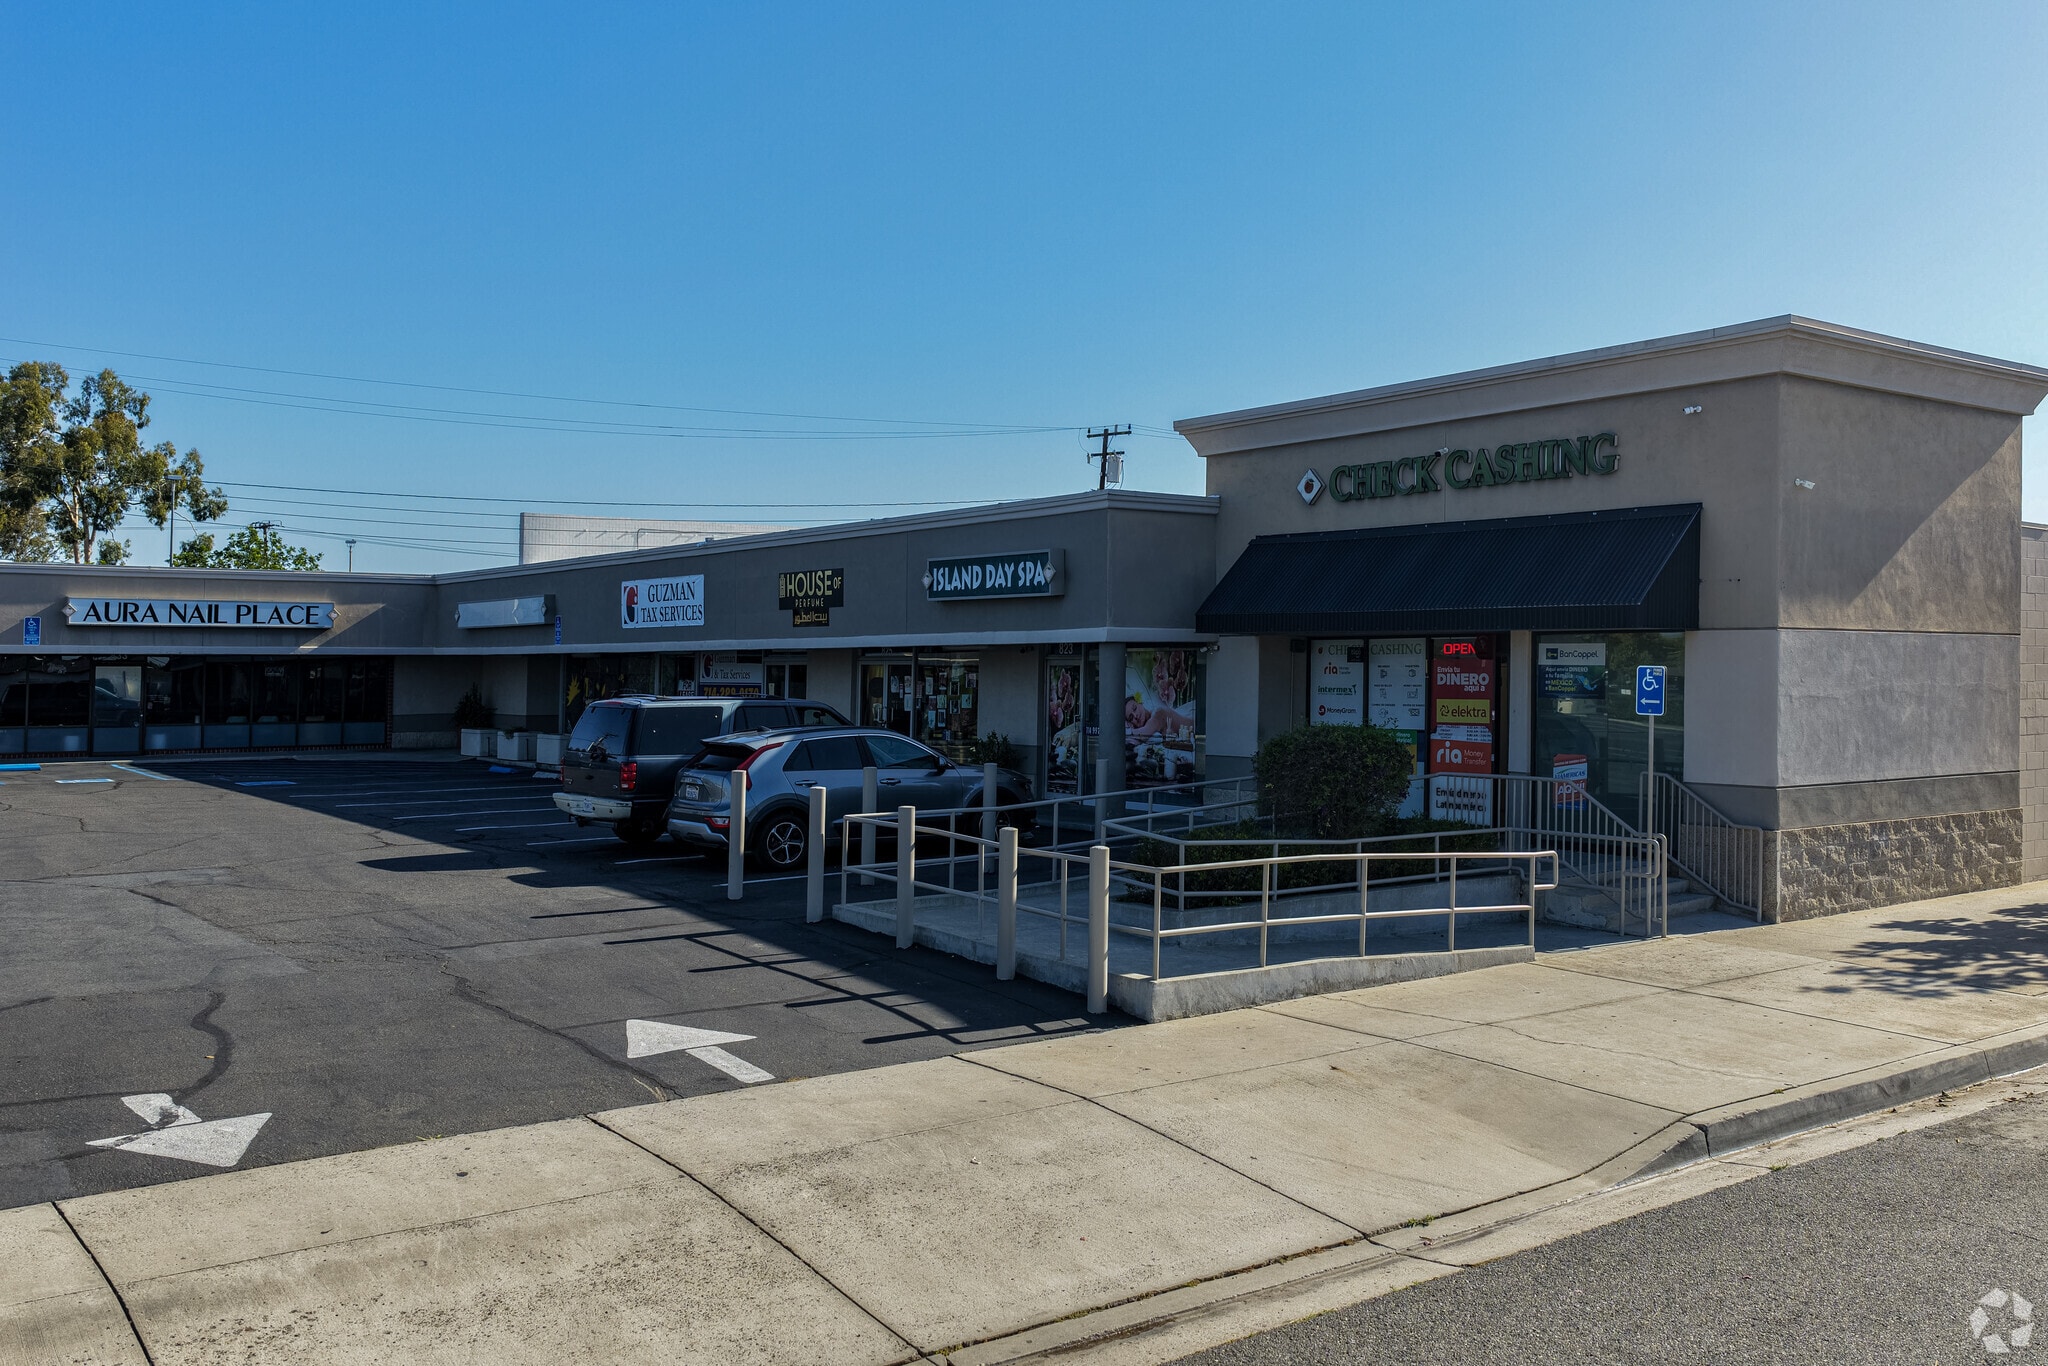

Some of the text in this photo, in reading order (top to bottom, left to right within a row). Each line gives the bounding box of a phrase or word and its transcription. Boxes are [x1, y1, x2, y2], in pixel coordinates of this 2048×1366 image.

[1329, 433, 1620, 502] CHECK CASHING
[932, 560, 1046, 591] ISLAND DAY SPA
[786, 570, 842, 597] HOUSE OF
[647, 581, 695, 603] GUZMAN
[795, 597, 824, 608] PERFUME
[83, 602, 319, 625] AURA NAIL PLACE
[641, 604, 702, 623] TAX SERVICES
[1059, 643, 1073, 655] 823
[1370, 643, 1422, 656] CASHING
[1559, 650, 1599, 660] BanCoppel
[729, 669, 751, 680] Services
[1324, 662, 1338, 675] ria
[1436, 673, 1490, 686] DINERO
[1318, 685, 1353, 693] intermex
[1326, 707, 1357, 715] MoneyGram
[1451, 706, 1487, 718] elektra
[1436, 740, 1462, 764] ria
[1464, 749, 1484, 758] Money
[1464, 757, 1487, 766] Transfer
